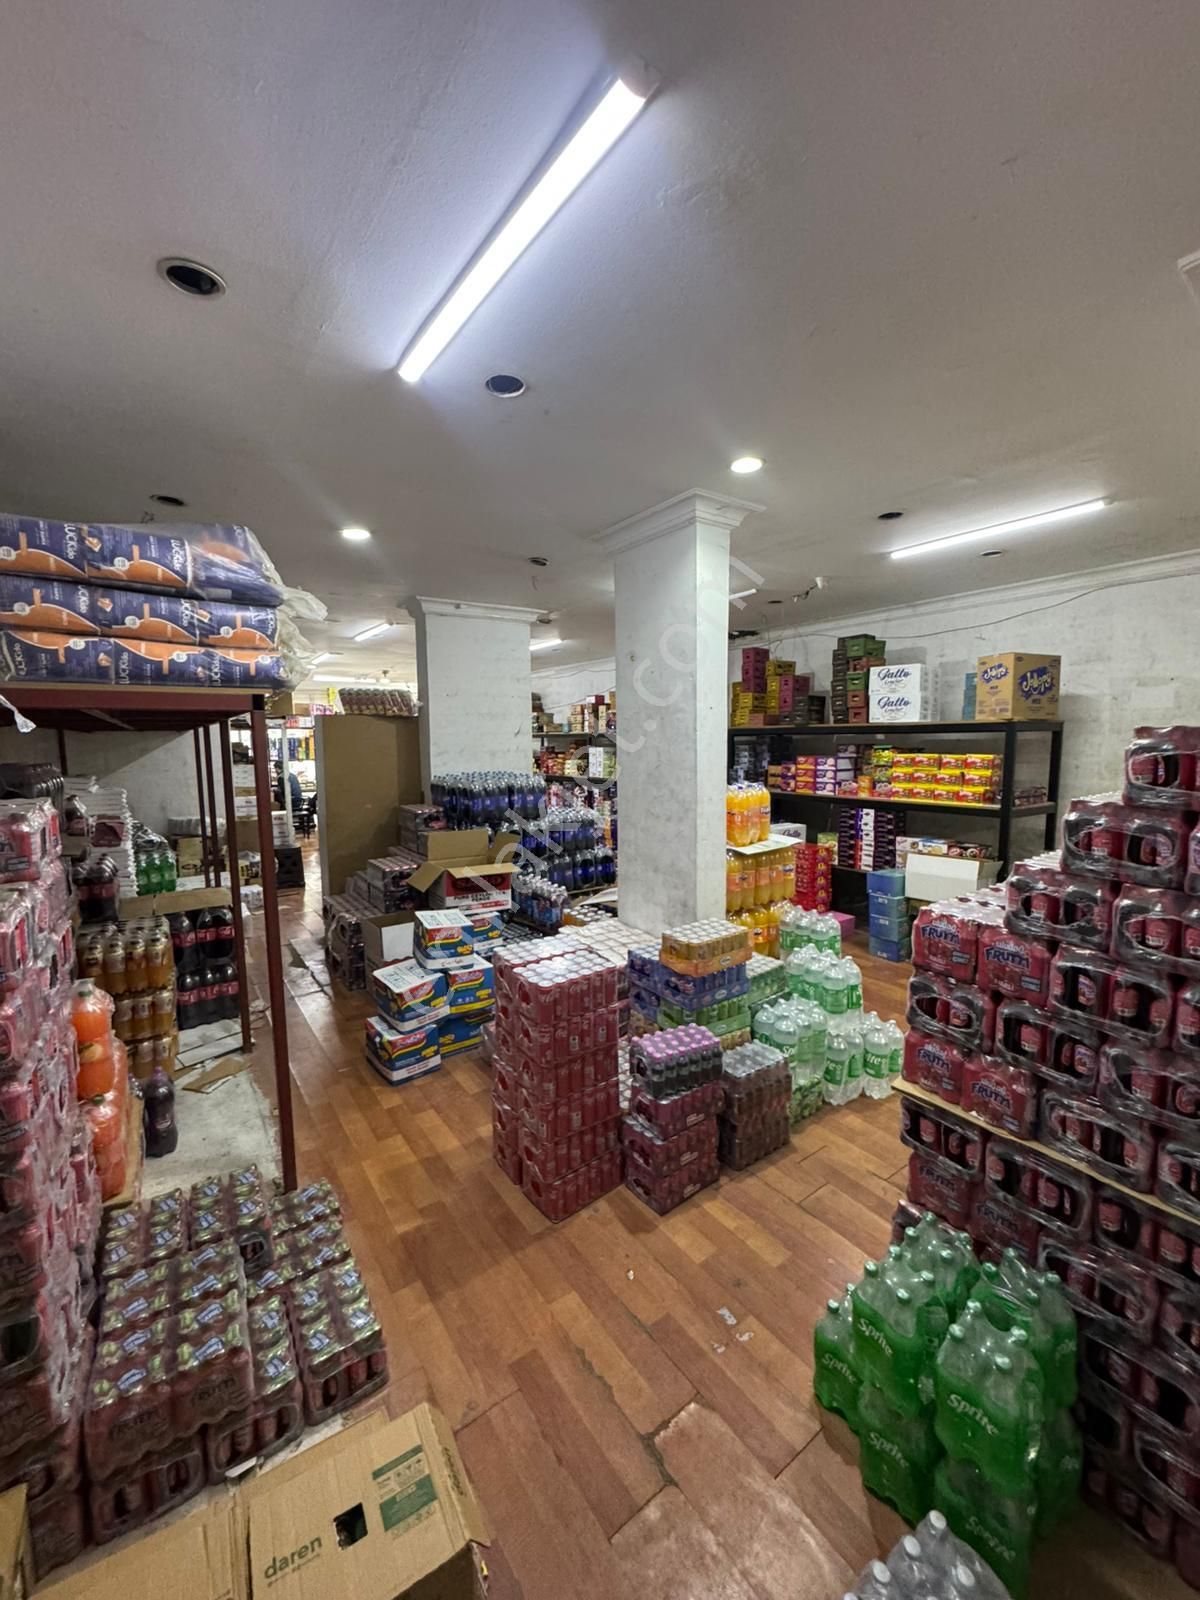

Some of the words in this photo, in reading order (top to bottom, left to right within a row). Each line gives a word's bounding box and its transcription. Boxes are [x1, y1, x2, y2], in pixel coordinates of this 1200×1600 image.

[857, 1318, 894, 1356] Sprite
[821, 1352, 857, 1385] Sprite
[947, 1393, 1000, 1437] Sprite
[868, 1431, 910, 1469] Sprite
[264, 1536, 323, 1580] daren
